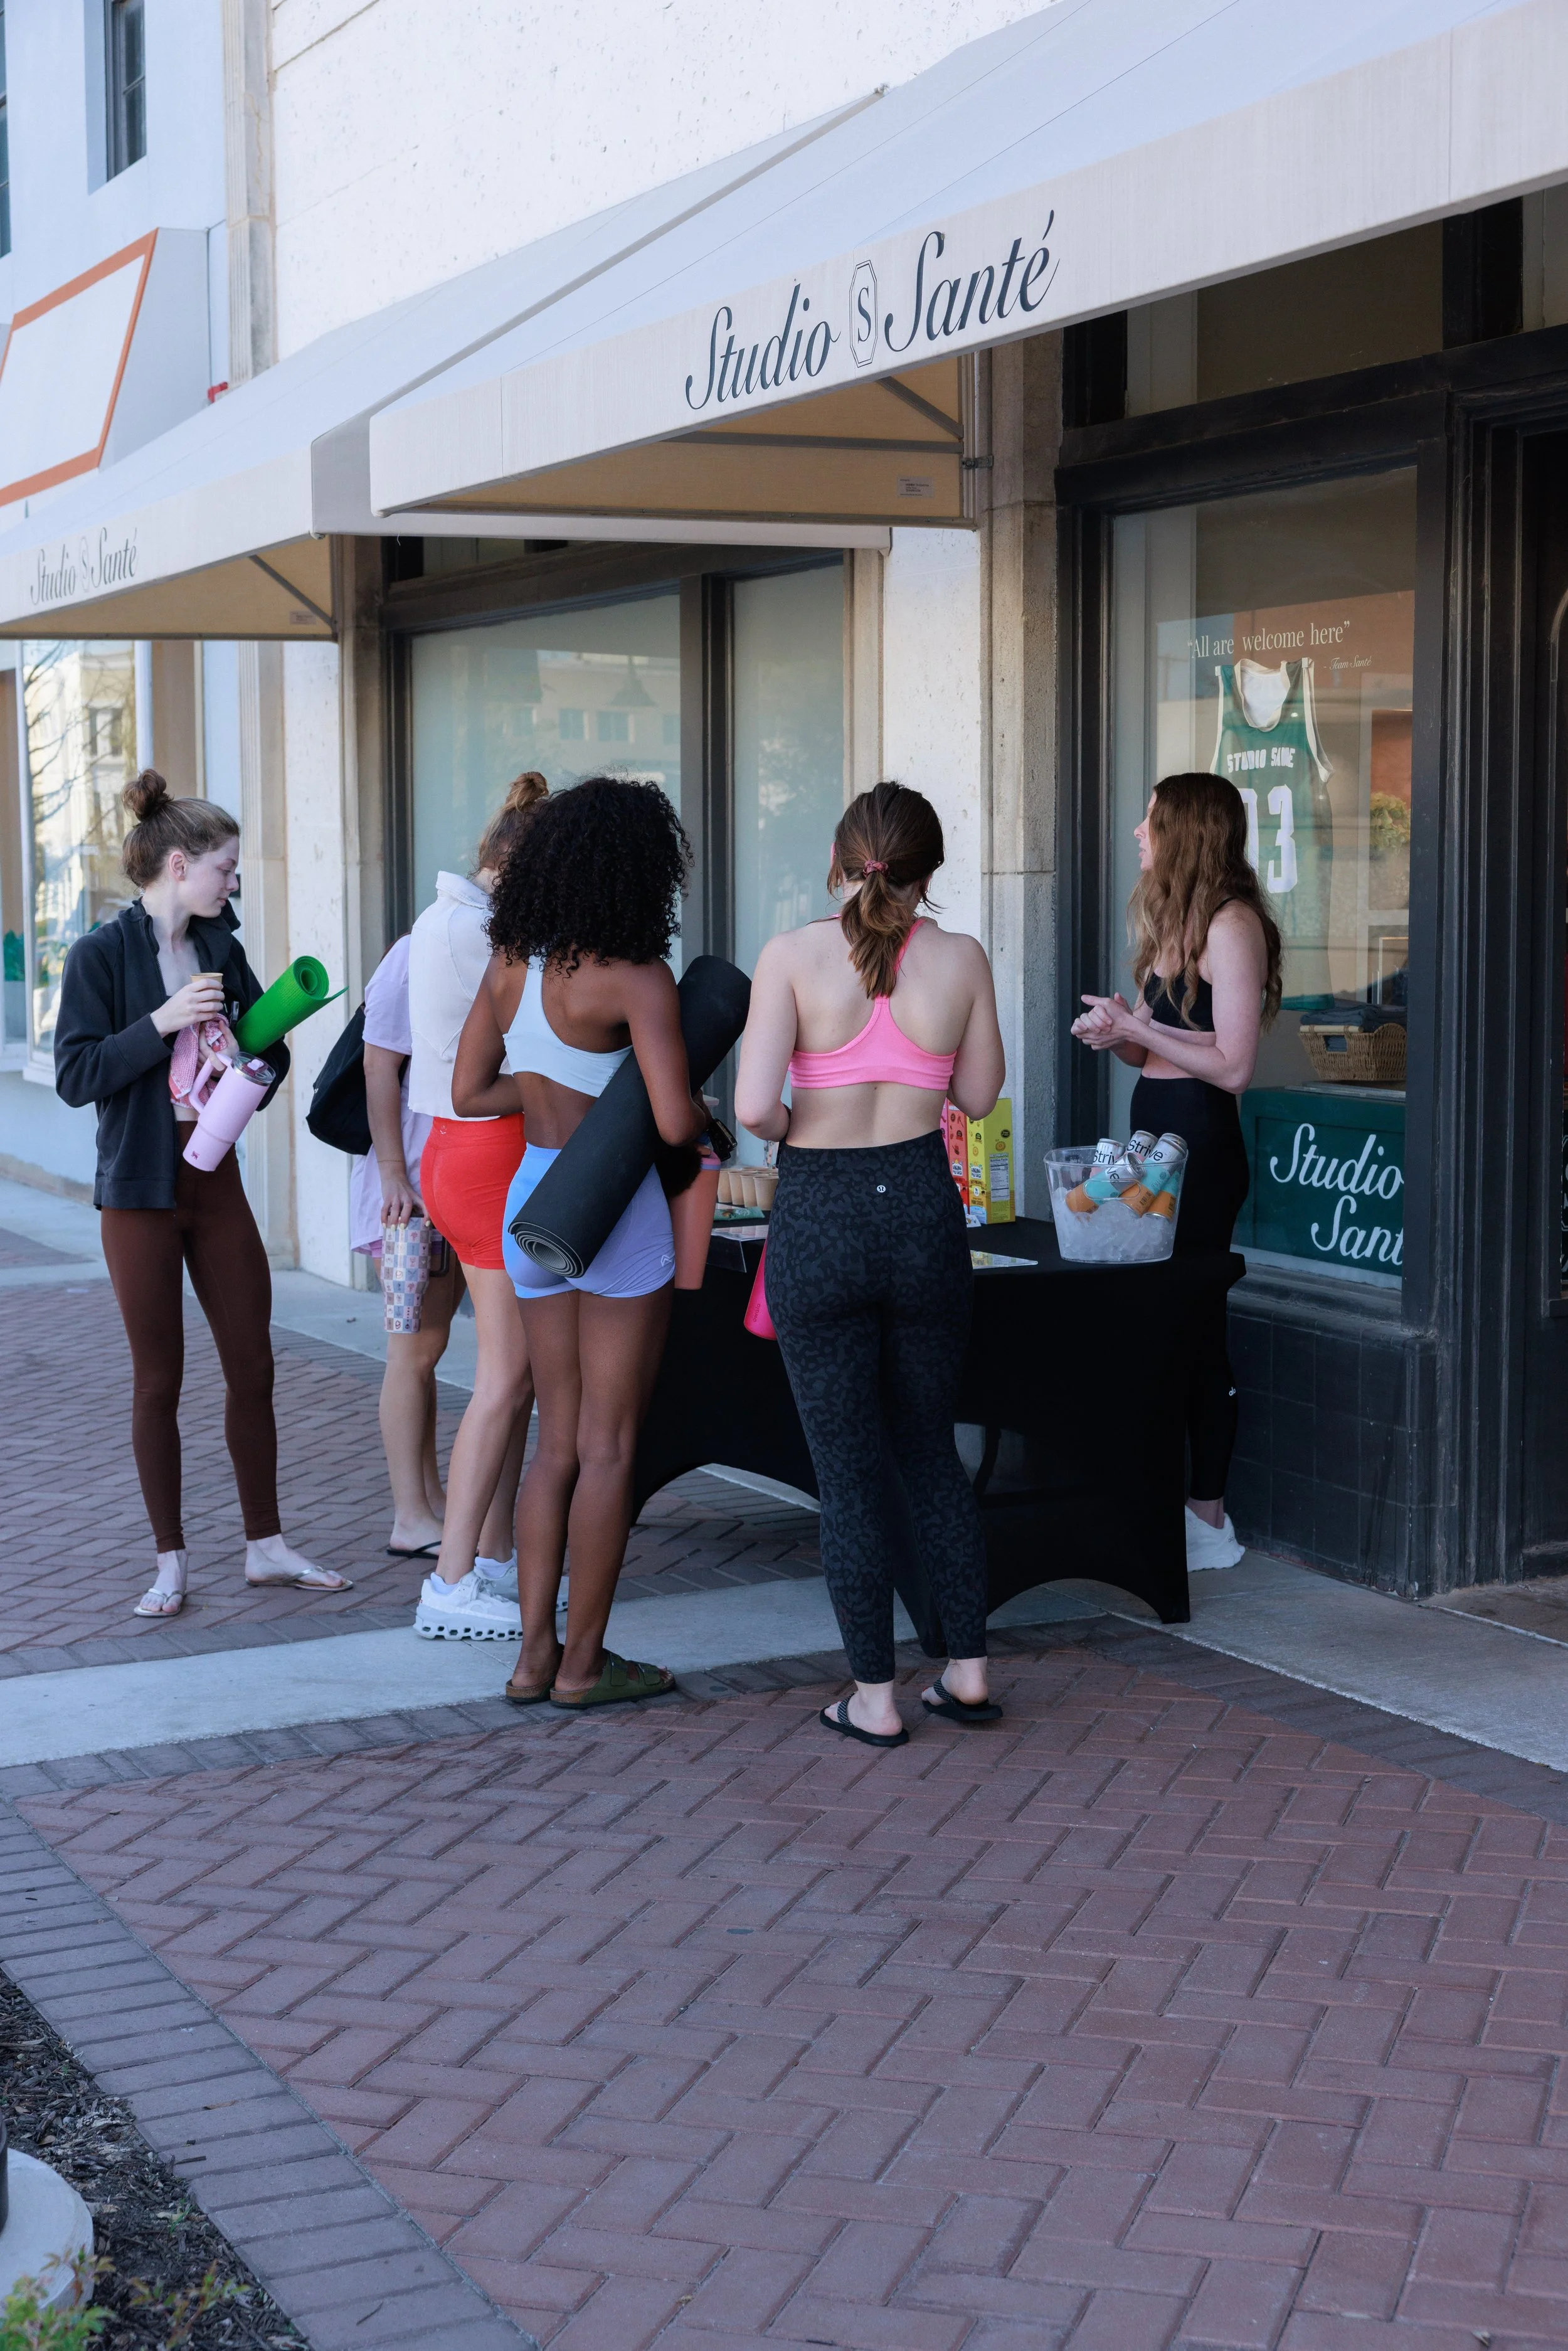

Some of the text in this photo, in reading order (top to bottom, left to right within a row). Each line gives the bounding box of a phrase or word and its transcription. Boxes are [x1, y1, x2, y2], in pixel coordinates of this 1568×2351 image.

[685, 283, 841, 410] Studio
[884, 209, 1061, 352] Santé
[30, 543, 77, 606] Studio
[91, 526, 139, 588] Santé
[1213, 637, 1234, 656] are
[1242, 627, 1305, 652] welcome
[1329, 657, 1349, 670] Team
[1350, 654, 1372, 668] Santé
[1227, 749, 1266, 773] STUDIO
[1269, 1123, 1404, 1200] Studio
